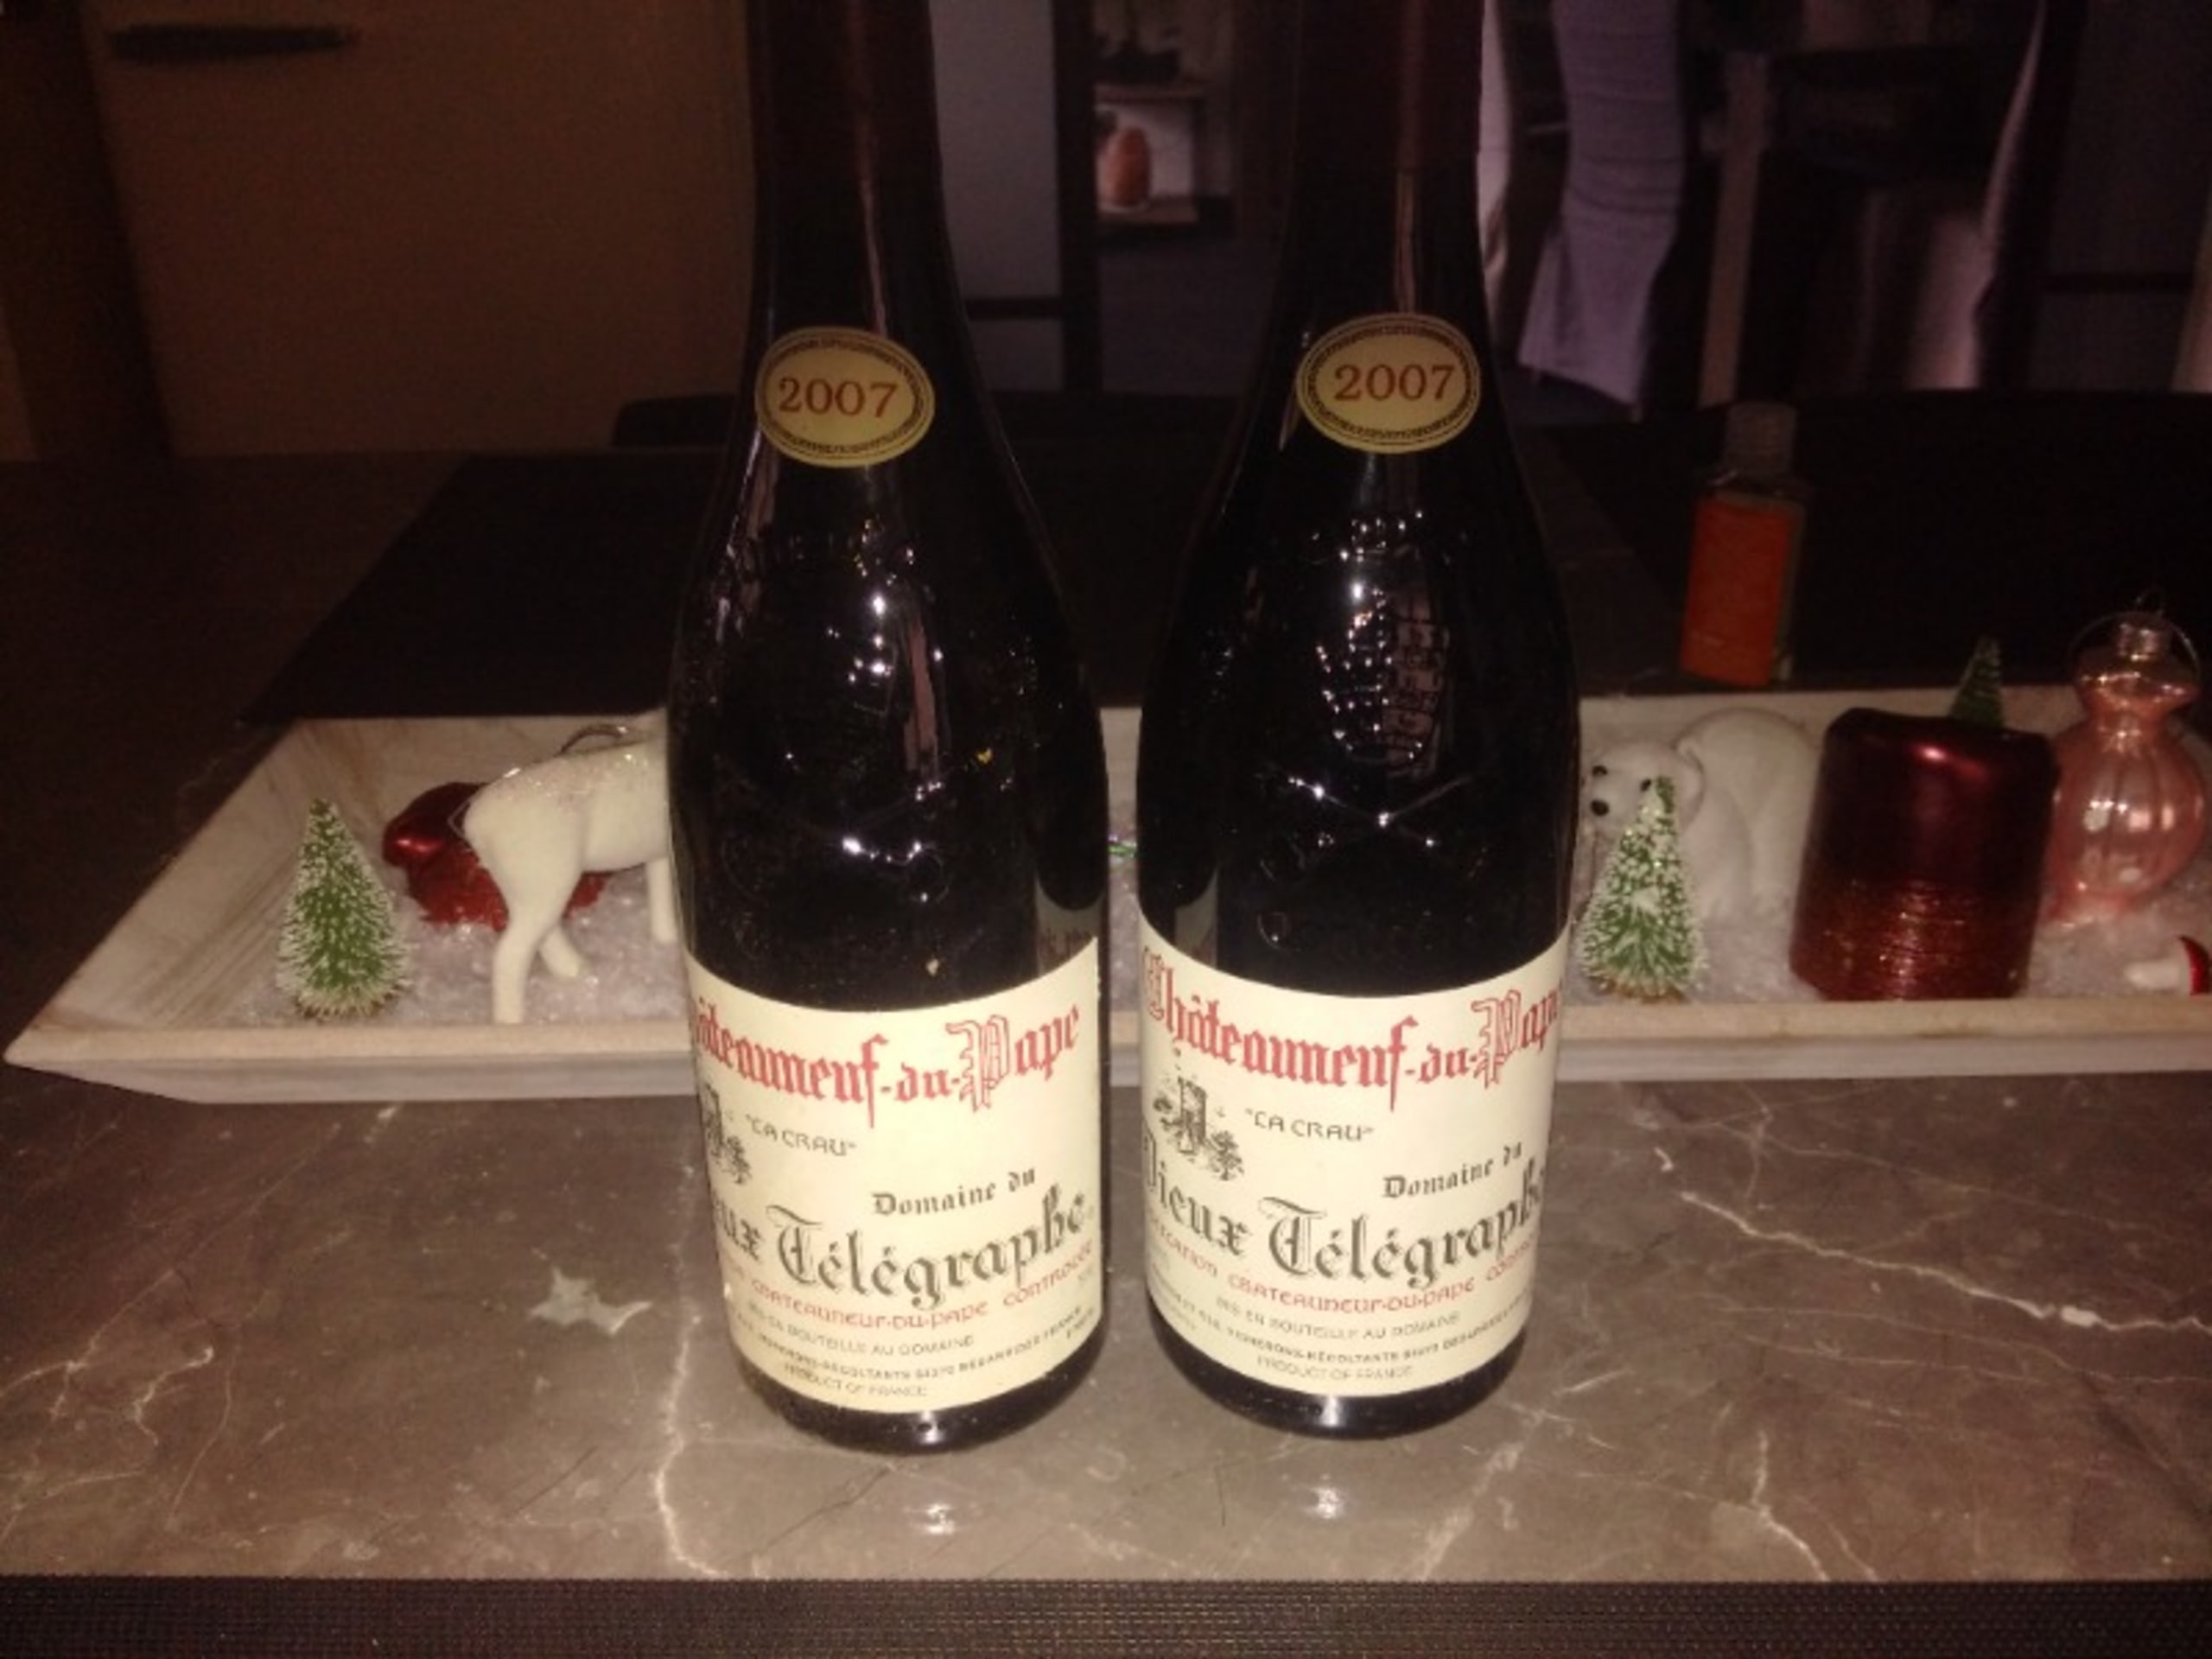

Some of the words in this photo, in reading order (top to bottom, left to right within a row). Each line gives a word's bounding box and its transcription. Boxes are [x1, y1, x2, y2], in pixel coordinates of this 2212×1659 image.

[779, 376, 899, 419] 2007
[1333, 363, 1455, 402] 2007
[1143, 947, 1561, 1113] Châteauneuf-du-Pap
[694, 996, 1080, 1128] âteauneuf-du-Pape
[872, 1181, 996, 1216] Domaine
[1007, 1167, 1036, 1192] du
[1382, 1160, 1494, 1199] Domaine
[1503, 1141, 1522, 1166] du
[766, 1183, 1086, 1311] Télégraphe
[1258, 1156, 1545, 1288] Télégraph
[871, 1343, 894, 1357] AU
[1363, 1327, 1386, 1340] AU
